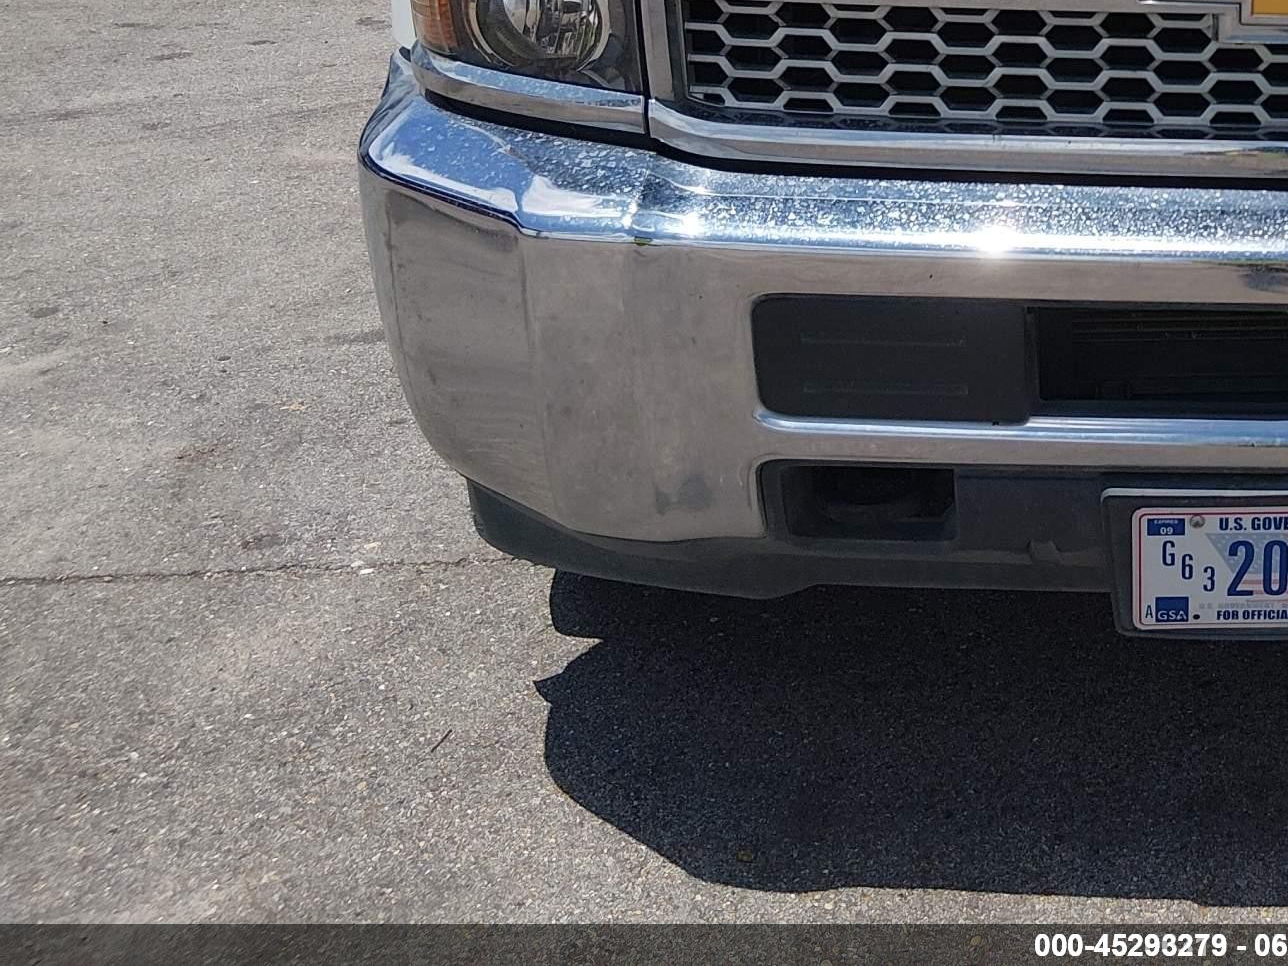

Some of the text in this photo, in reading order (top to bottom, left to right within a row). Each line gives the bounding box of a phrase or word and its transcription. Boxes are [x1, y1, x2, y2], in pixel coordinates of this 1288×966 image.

[1159, 526, 1174, 535] 09
[1218, 517, 1248, 531] U.S.
[1145, 605, 1154, 619] A
[1157, 609, 1188, 622] GSA
[1216, 609, 1239, 621] FOR
